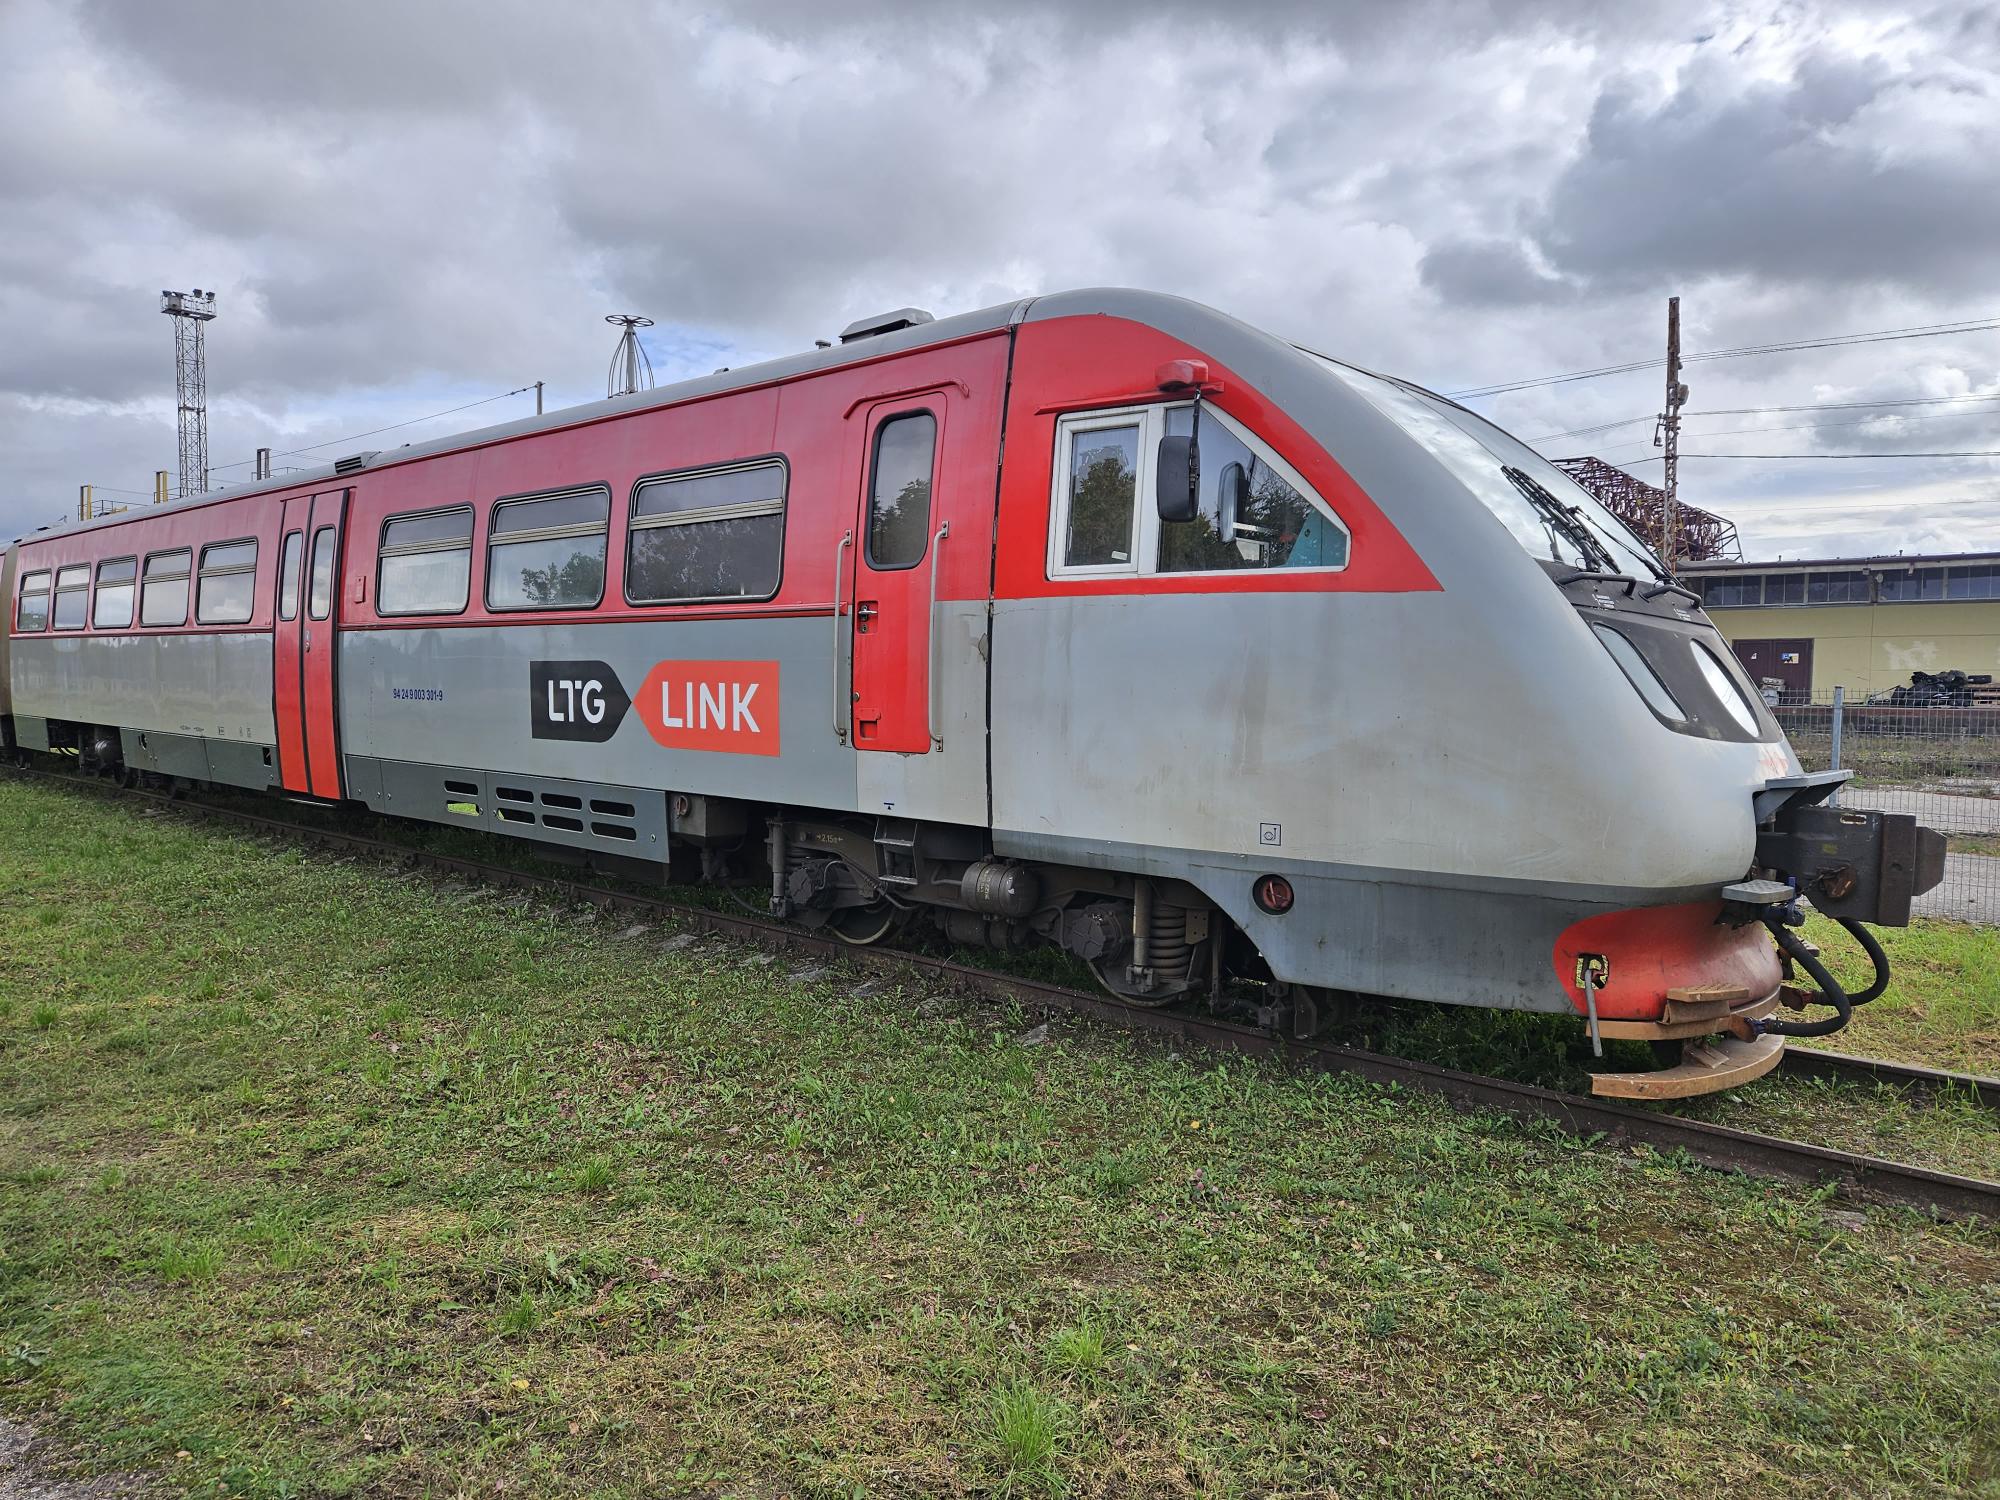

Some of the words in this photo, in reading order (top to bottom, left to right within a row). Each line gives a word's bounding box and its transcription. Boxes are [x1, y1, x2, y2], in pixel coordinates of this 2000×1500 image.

[393, 688, 401, 699] 94
[402, 689, 409, 700] 24
[548, 680, 606, 724] LTG
[662, 681, 761, 733] LINK
